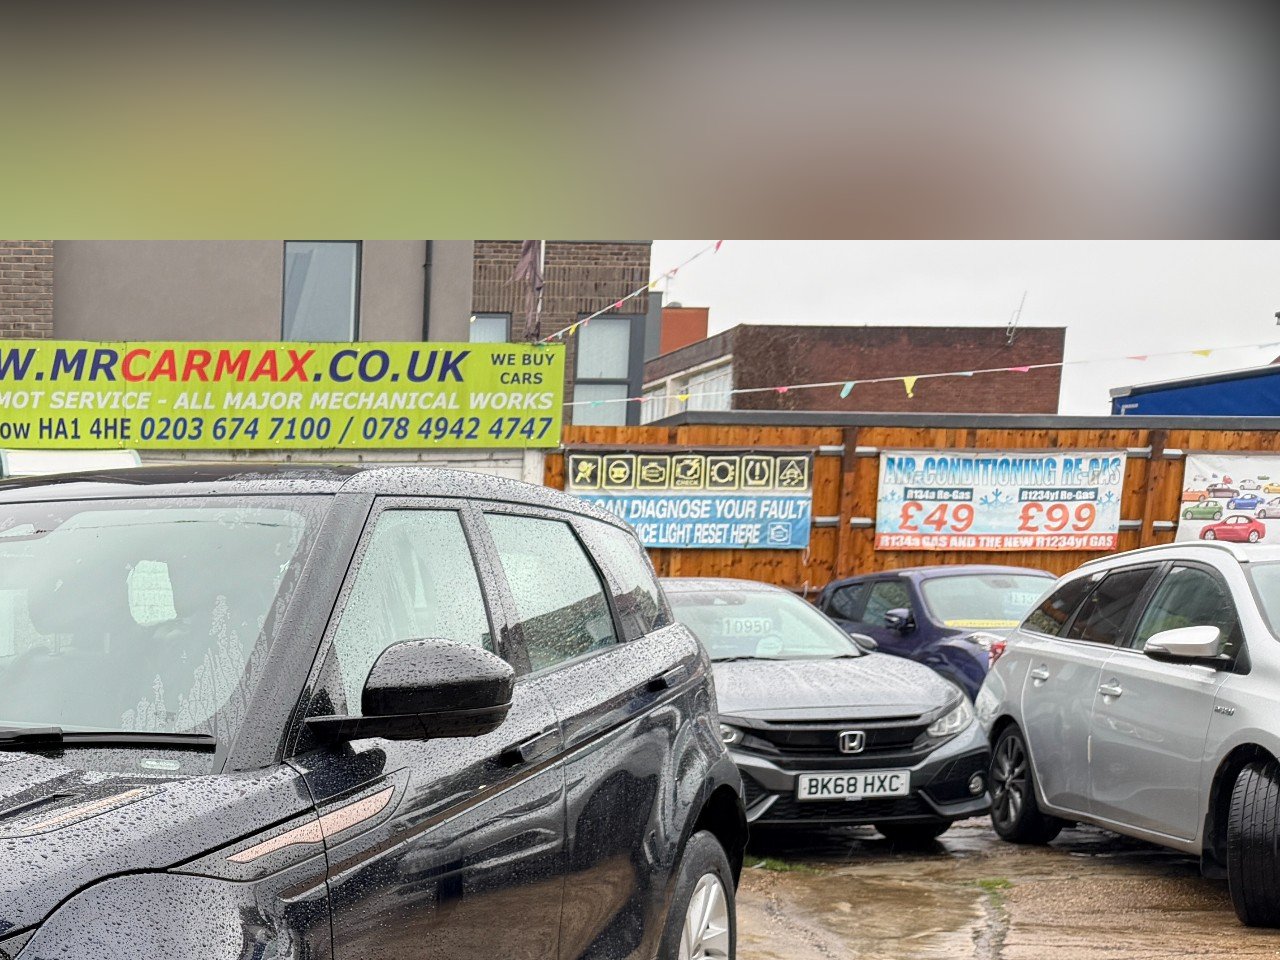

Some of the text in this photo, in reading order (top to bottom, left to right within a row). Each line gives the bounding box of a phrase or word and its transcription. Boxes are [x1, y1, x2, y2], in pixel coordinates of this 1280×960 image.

[491, 353, 555, 366] WE BUY
[500, 371, 543, 385] CARS
[49, 391, 150, 410] SERVICE
[174, 392, 215, 410] ALL
[222, 392, 304, 410] MAJOR
[310, 392, 460, 410] MECHANICAL
[467, 392, 553, 410] WORKS
[39, 417, 81, 440] HA1
[89, 418, 131, 440] 4HE
[140, 417, 204, 440] 0203
[212, 417, 259, 440] 674
[269, 417, 331, 440] 7100
[362, 417, 409, 440] 078
[418, 417, 480, 440] 4942
[489, 417, 552, 440] 4747
[1061, 457, 1121, 486] RE-GAS
[630, 499, 712, 519] DIAGNOSE
[715, 500, 756, 519] YOUR
[759, 501, 809, 519] FAULT
[898, 501, 974, 532] £49
[1018, 502, 1096, 532] £99
[659, 524, 692, 543] LIGHT
[694, 524, 729, 543] RESET
[730, 525, 760, 543] HERE
[922, 536, 947, 547] GAS
[949, 536, 976, 547] AND
[978, 536, 1002, 547] THE
[1003, 536, 1034, 547] NEW
[1089, 536, 1113, 547] GAS
[807, 775, 900, 795] BK68 HXC
